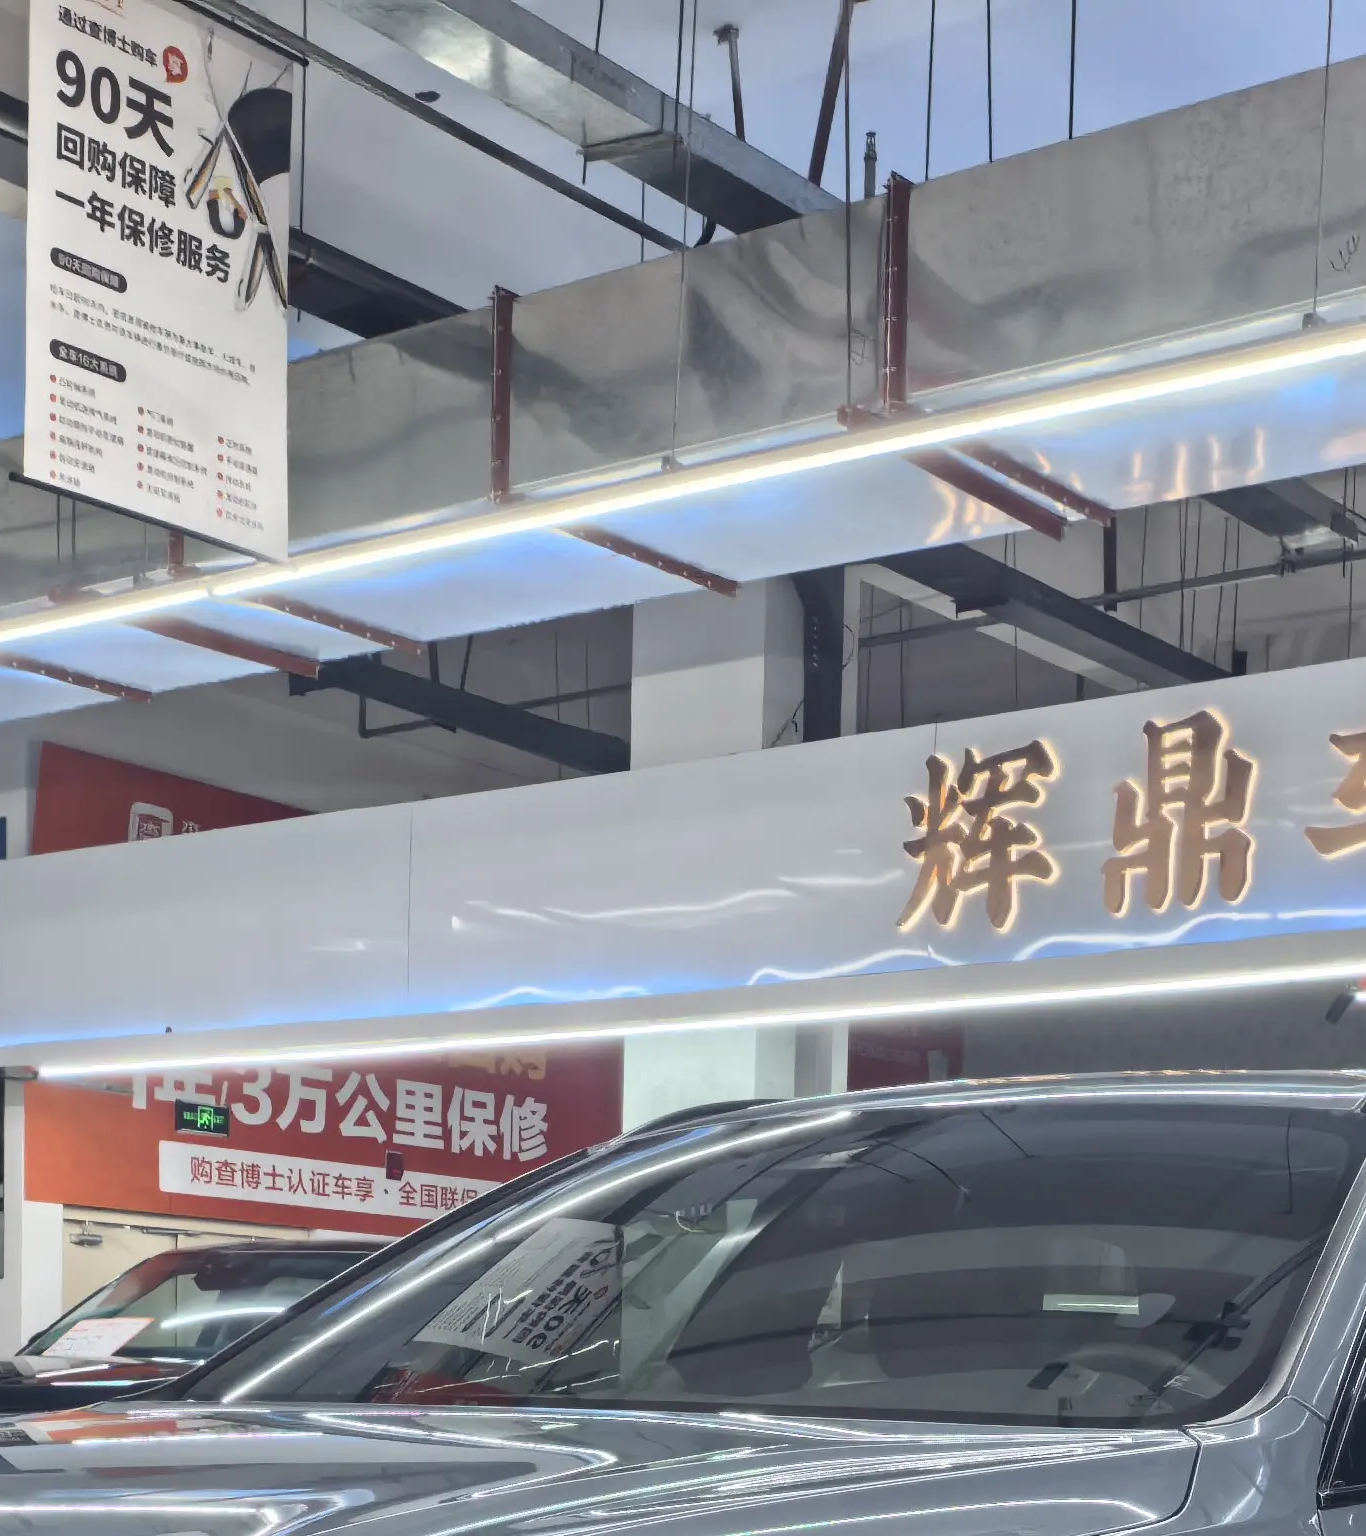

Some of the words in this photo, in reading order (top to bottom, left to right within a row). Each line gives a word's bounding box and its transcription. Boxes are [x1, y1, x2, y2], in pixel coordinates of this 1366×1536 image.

[56, 50, 174, 157] 90天
[56, 122, 176, 208] 回购保障
[55, 190, 231, 283] 一年保修服务
